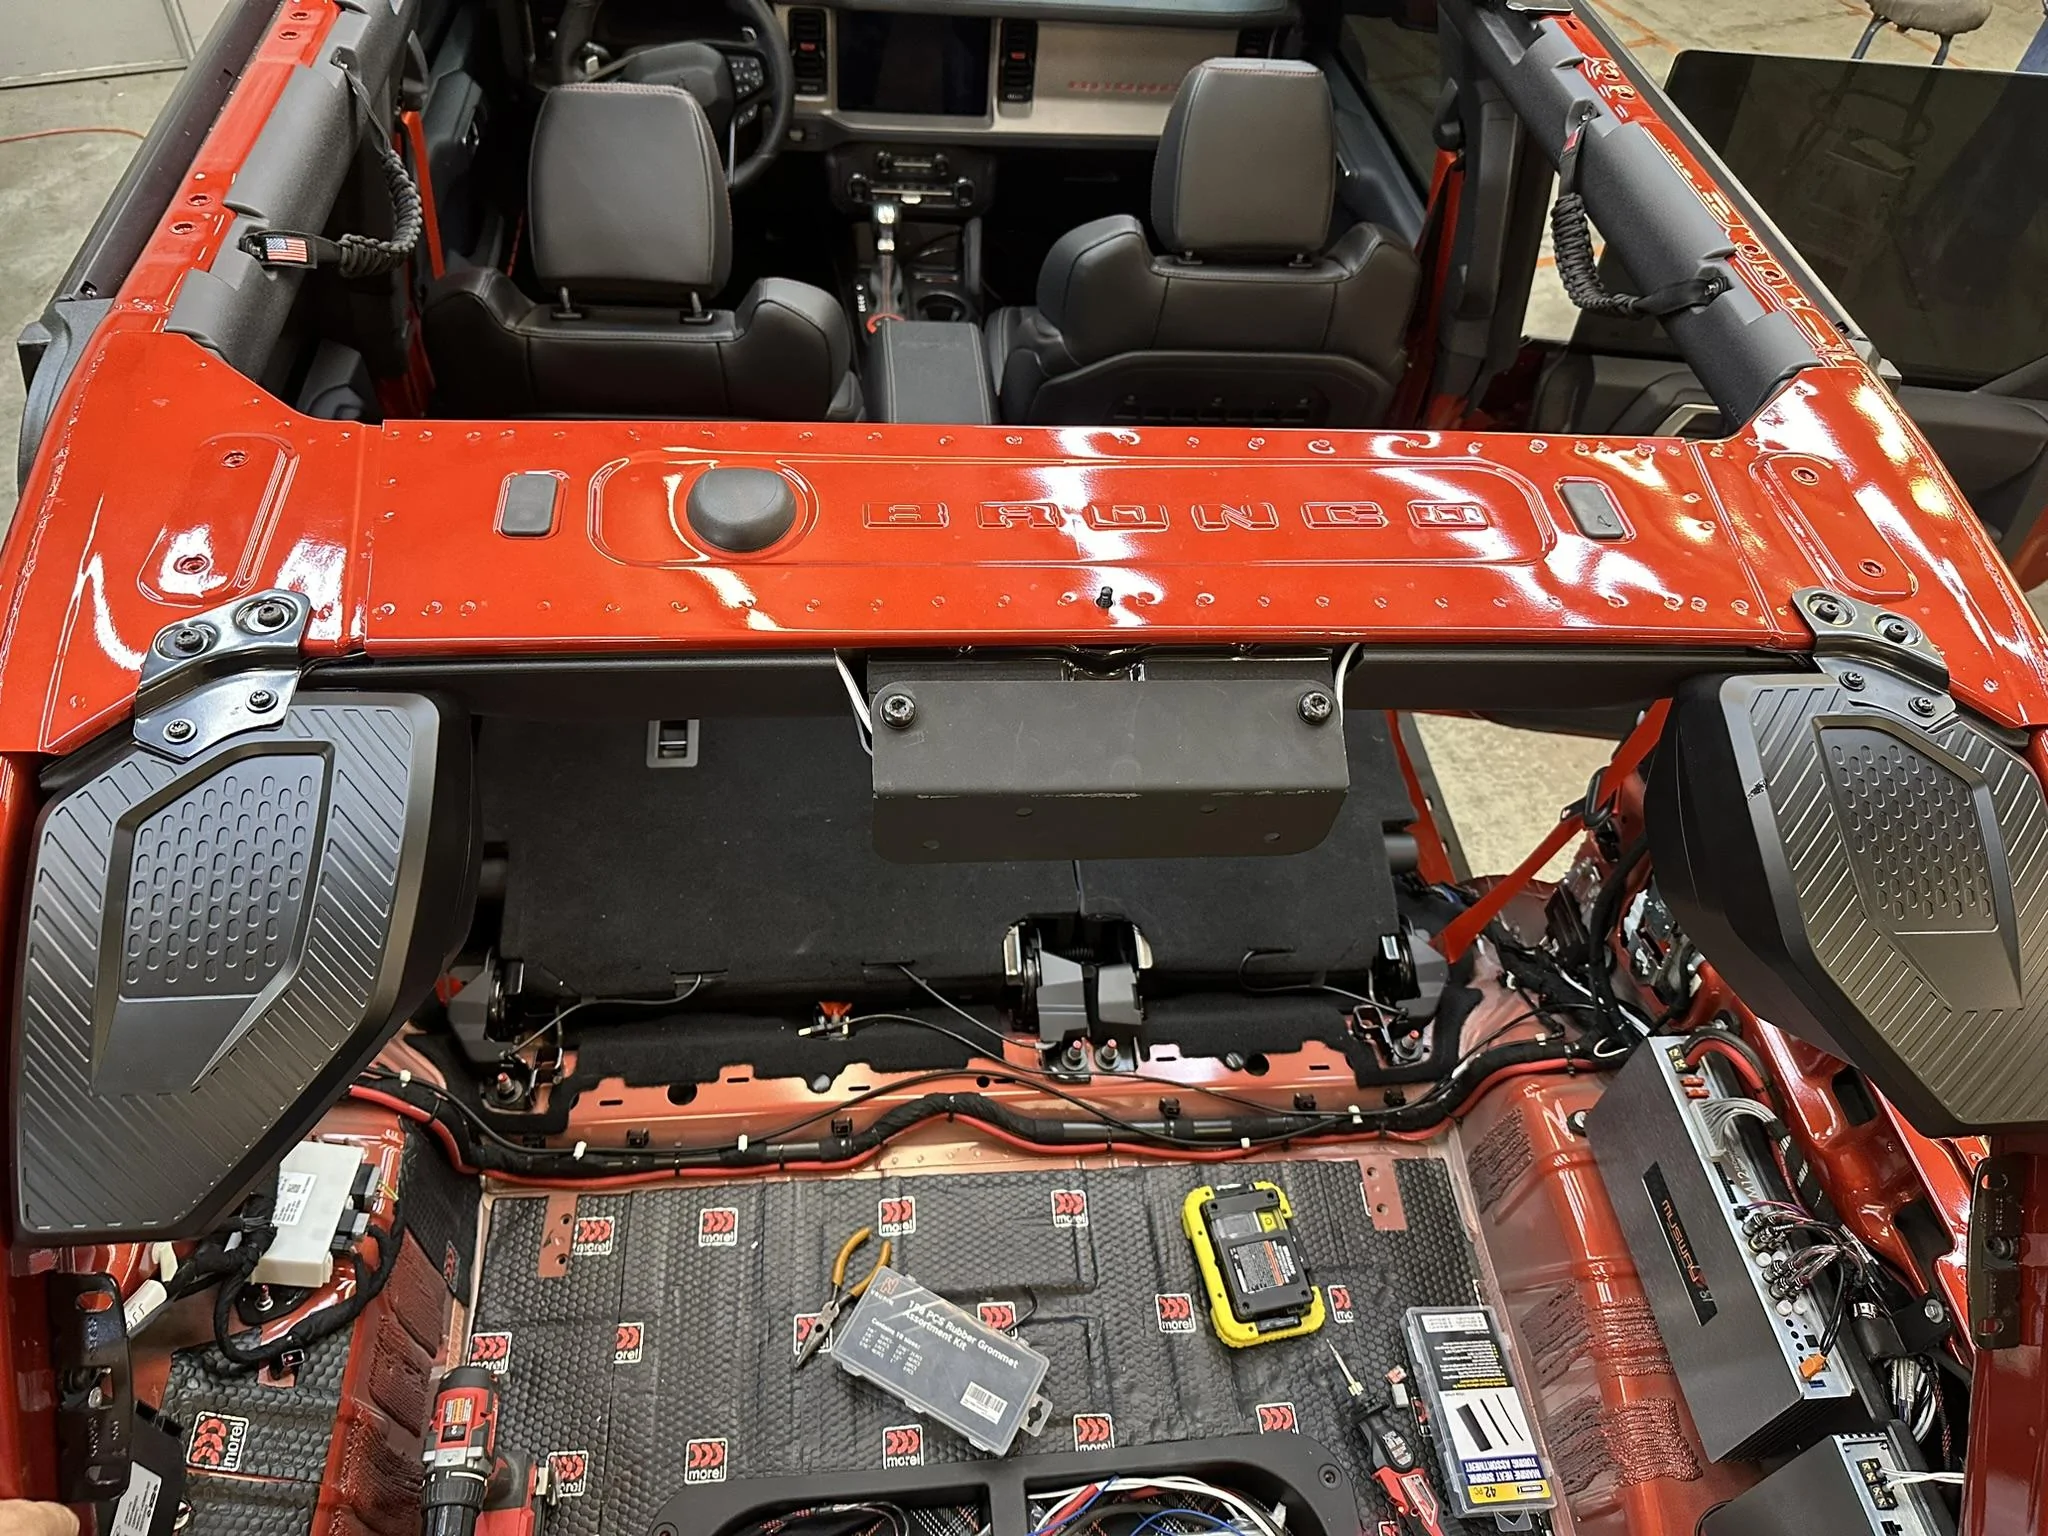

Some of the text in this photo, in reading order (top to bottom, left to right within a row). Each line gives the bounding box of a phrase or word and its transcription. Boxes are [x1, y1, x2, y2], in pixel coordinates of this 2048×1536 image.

[862, 498, 1489, 532] BRONCO
[702, 1231, 734, 1242] morel
[904, 1310, 952, 1343] Assortment
[953, 1337, 967, 1351] Kit
[1162, 1317, 1193, 1330] morel
[926, 1309, 945, 1326] PCS
[945, 1319, 976, 1344] Rubber
[977, 1339, 1019, 1369] Grommet
[616, 1348, 639, 1360] orel
[224, 1422, 245, 1466] morel
[887, 1453, 920, 1468] morel
[1465, 1460, 1511, 1472] ASSORTMENT
[688, 1465, 723, 1480] morel
[1496, 1472, 1514, 1482] HEAT
[1485, 1486, 1496, 1498] 42
